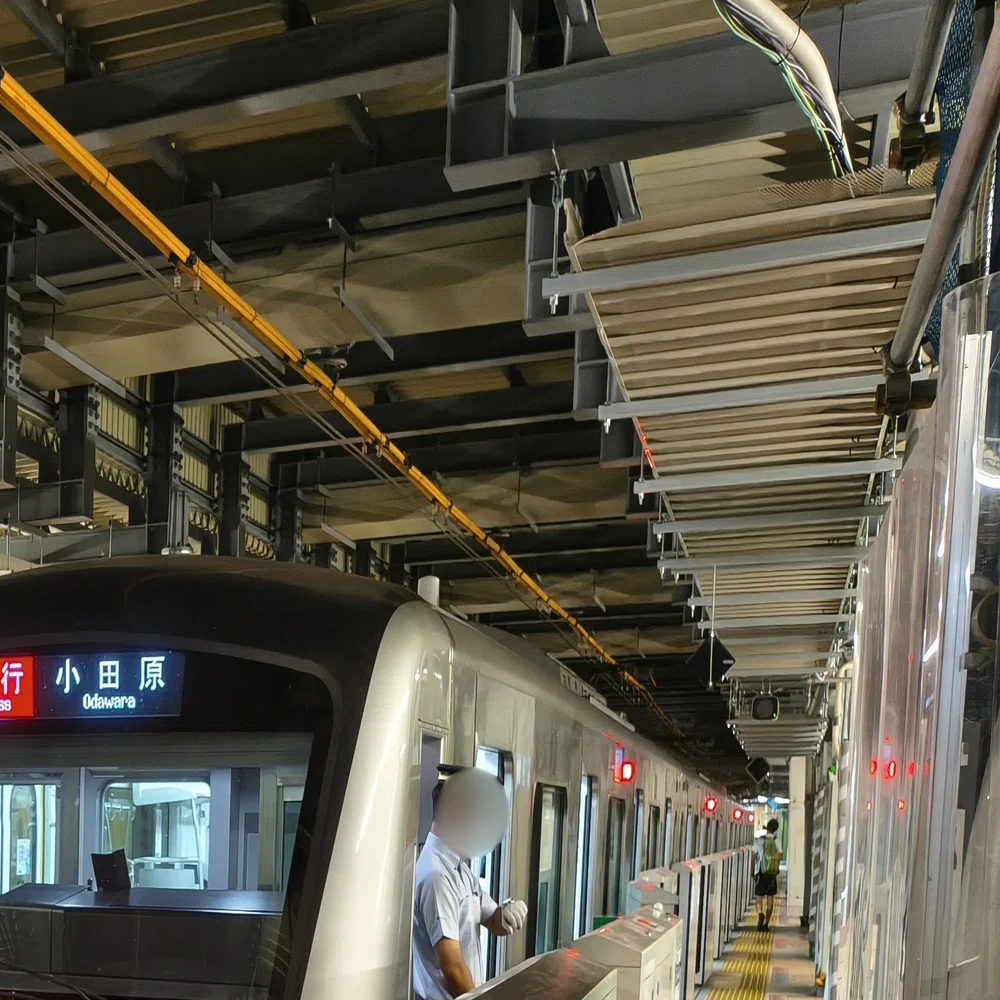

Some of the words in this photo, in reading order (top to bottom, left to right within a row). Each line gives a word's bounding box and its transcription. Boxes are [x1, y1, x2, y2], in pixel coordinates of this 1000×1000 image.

[55, 655, 166, 694] 小田原
[82, 692, 136, 710] Odawara
